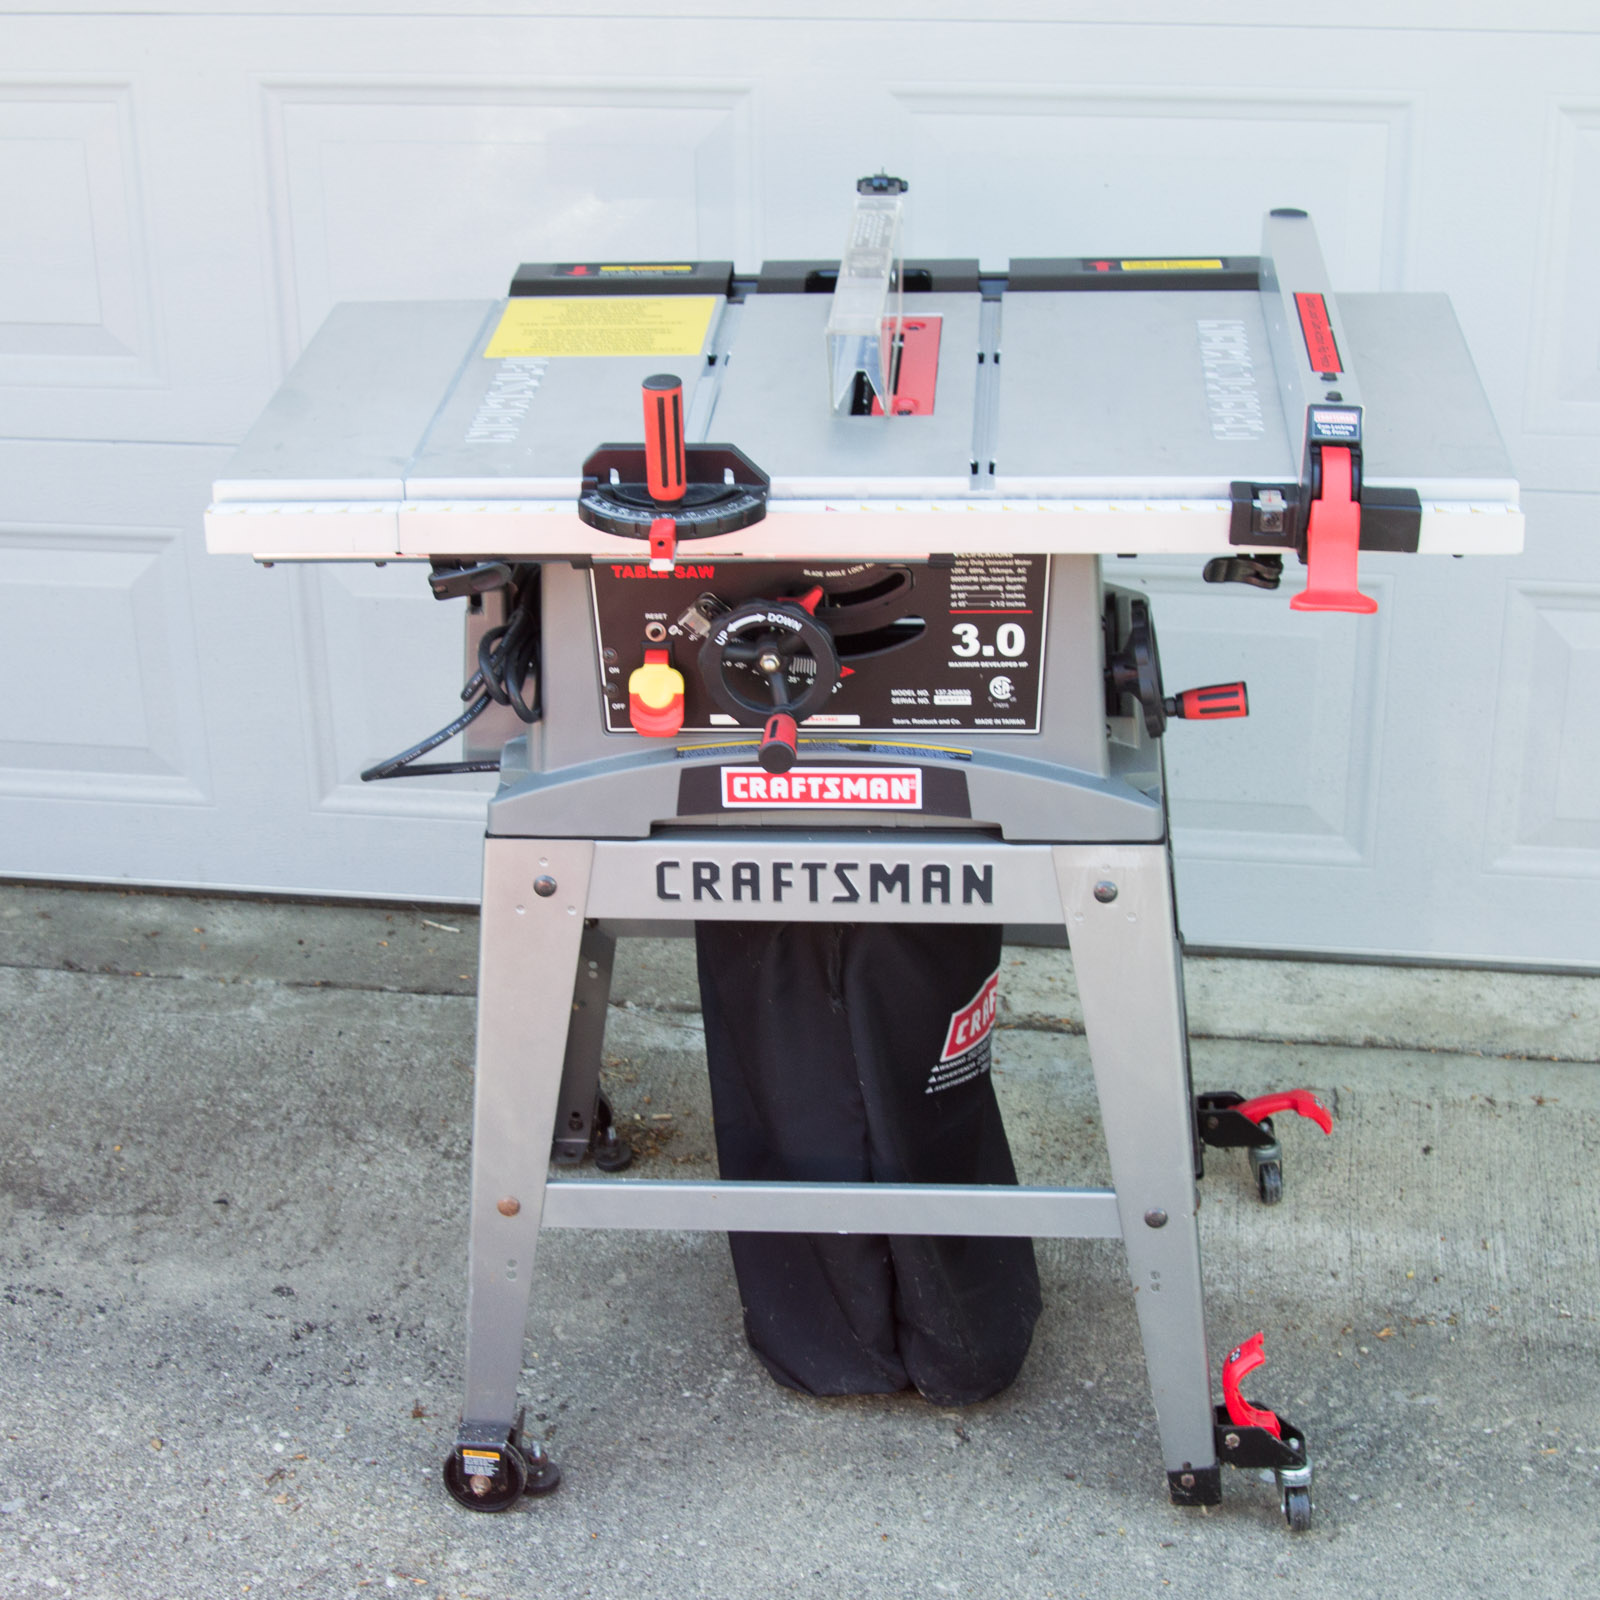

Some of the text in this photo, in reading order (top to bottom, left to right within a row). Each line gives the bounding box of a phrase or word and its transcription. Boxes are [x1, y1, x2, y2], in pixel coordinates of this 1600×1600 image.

[674, 565, 715, 579] SAW
[803, 569, 824, 577] BLADE
[847, 564, 865, 575] LOCK
[714, 612, 802, 646] UP DOWN
[952, 623, 1026, 658] 3.0
[733, 777, 911, 800] CRAFTSMAN
[656, 861, 993, 904] CRAFTSMAN
